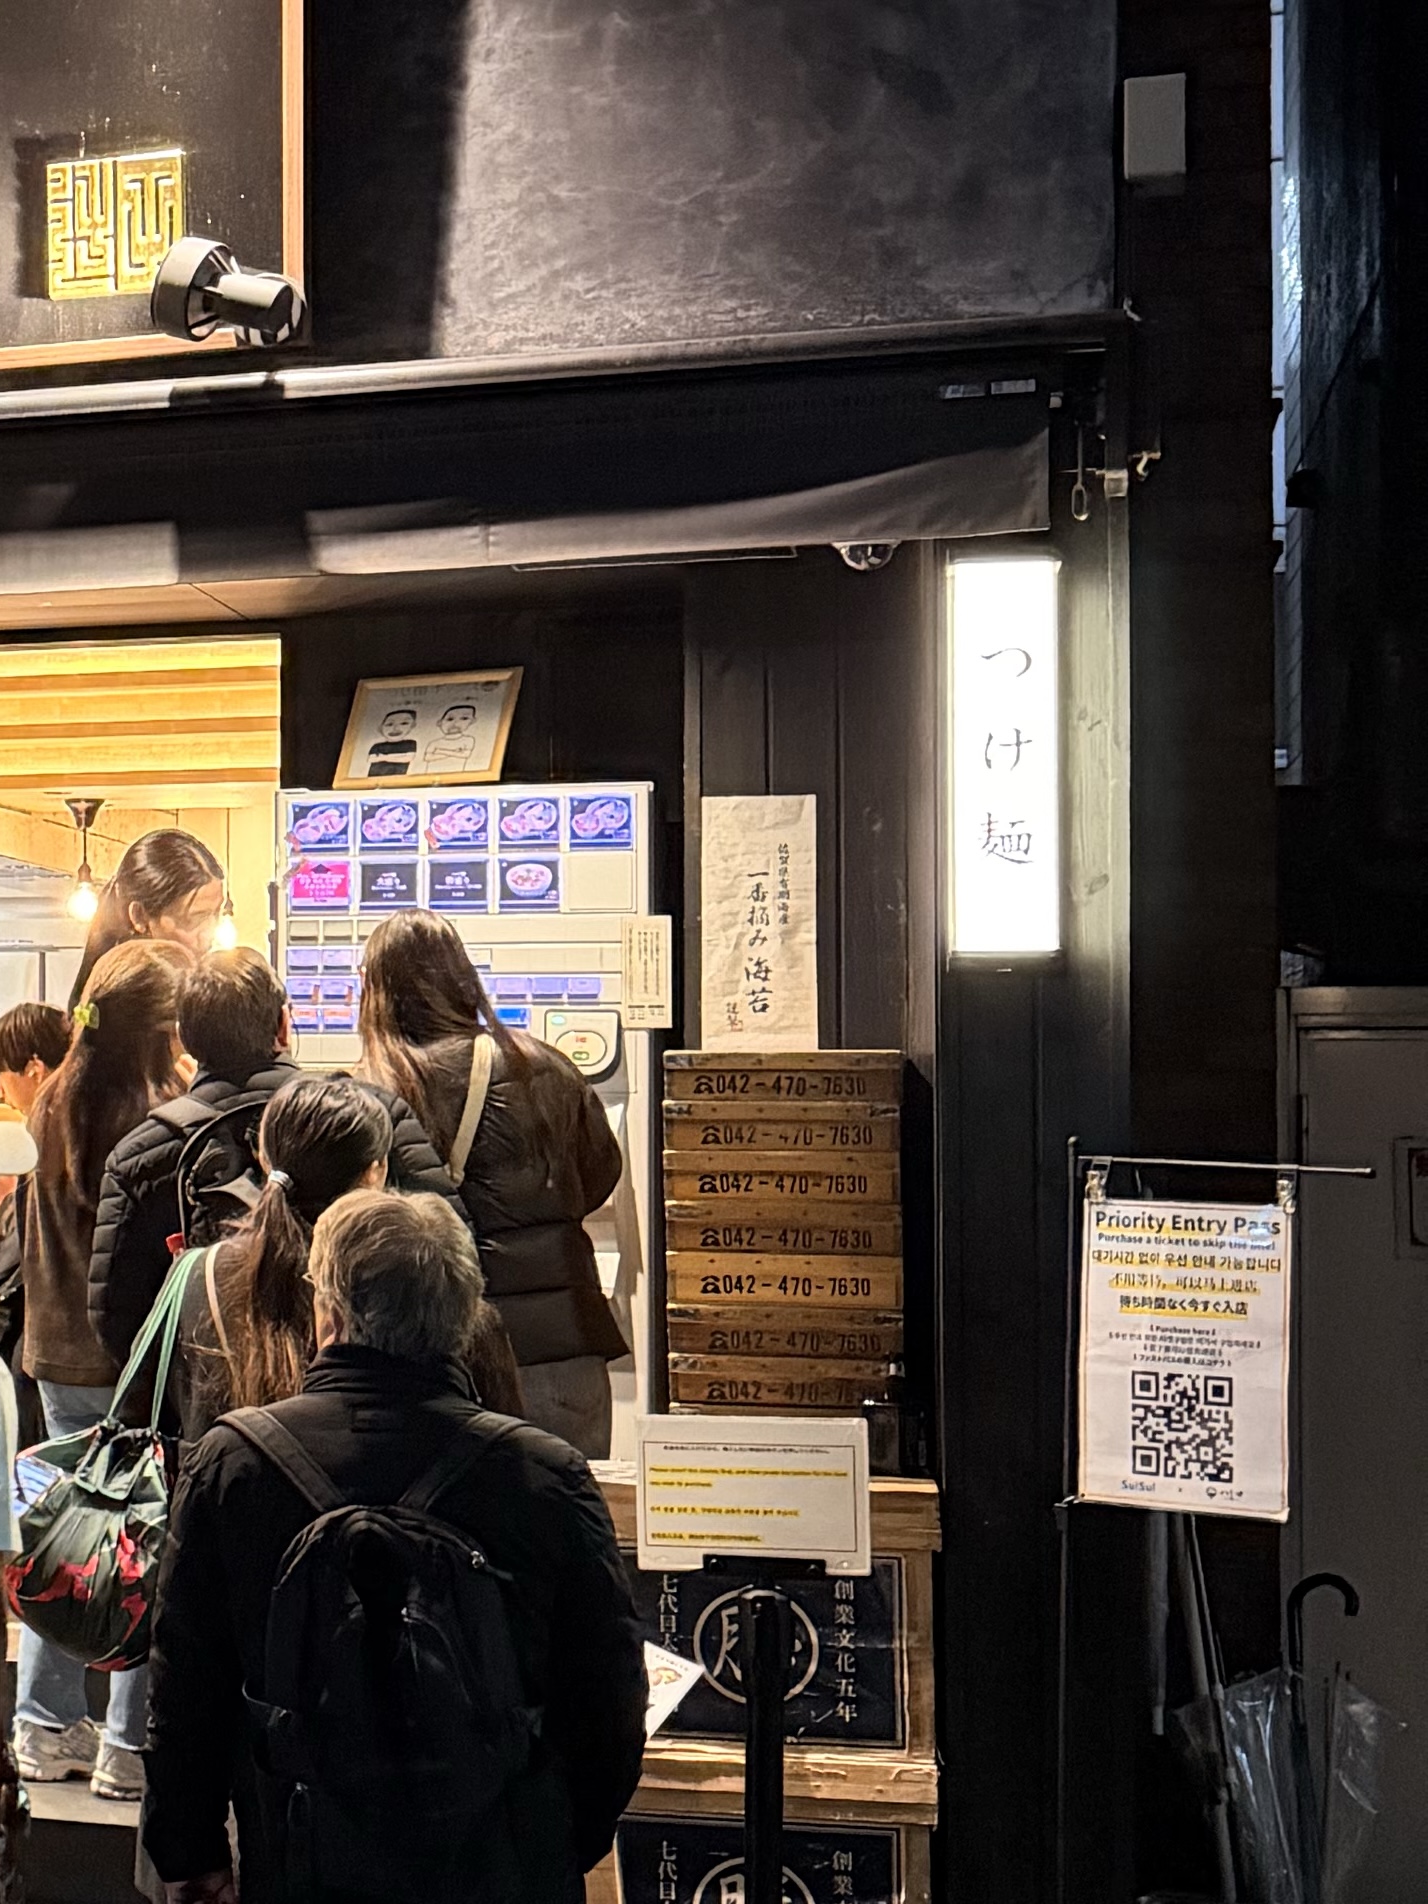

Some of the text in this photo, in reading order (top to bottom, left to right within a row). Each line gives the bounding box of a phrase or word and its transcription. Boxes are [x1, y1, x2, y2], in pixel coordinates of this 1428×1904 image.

[977, 647, 1035, 866] つけ麺
[1095, 1210, 1166, 1234] Priority
[1171, 1214, 1227, 1236] Entry
[1098, 1232, 1143, 1245] Purchase
[1145, 1236, 1151, 1244] a
[1154, 1235, 1185, 1246] ticket
[1188, 1238, 1200, 1247] to
[1202, 1238, 1226, 1250] skip
[1092, 1249, 1135, 1265] 대기시간
[1138, 1251, 1160, 1266] 없이
